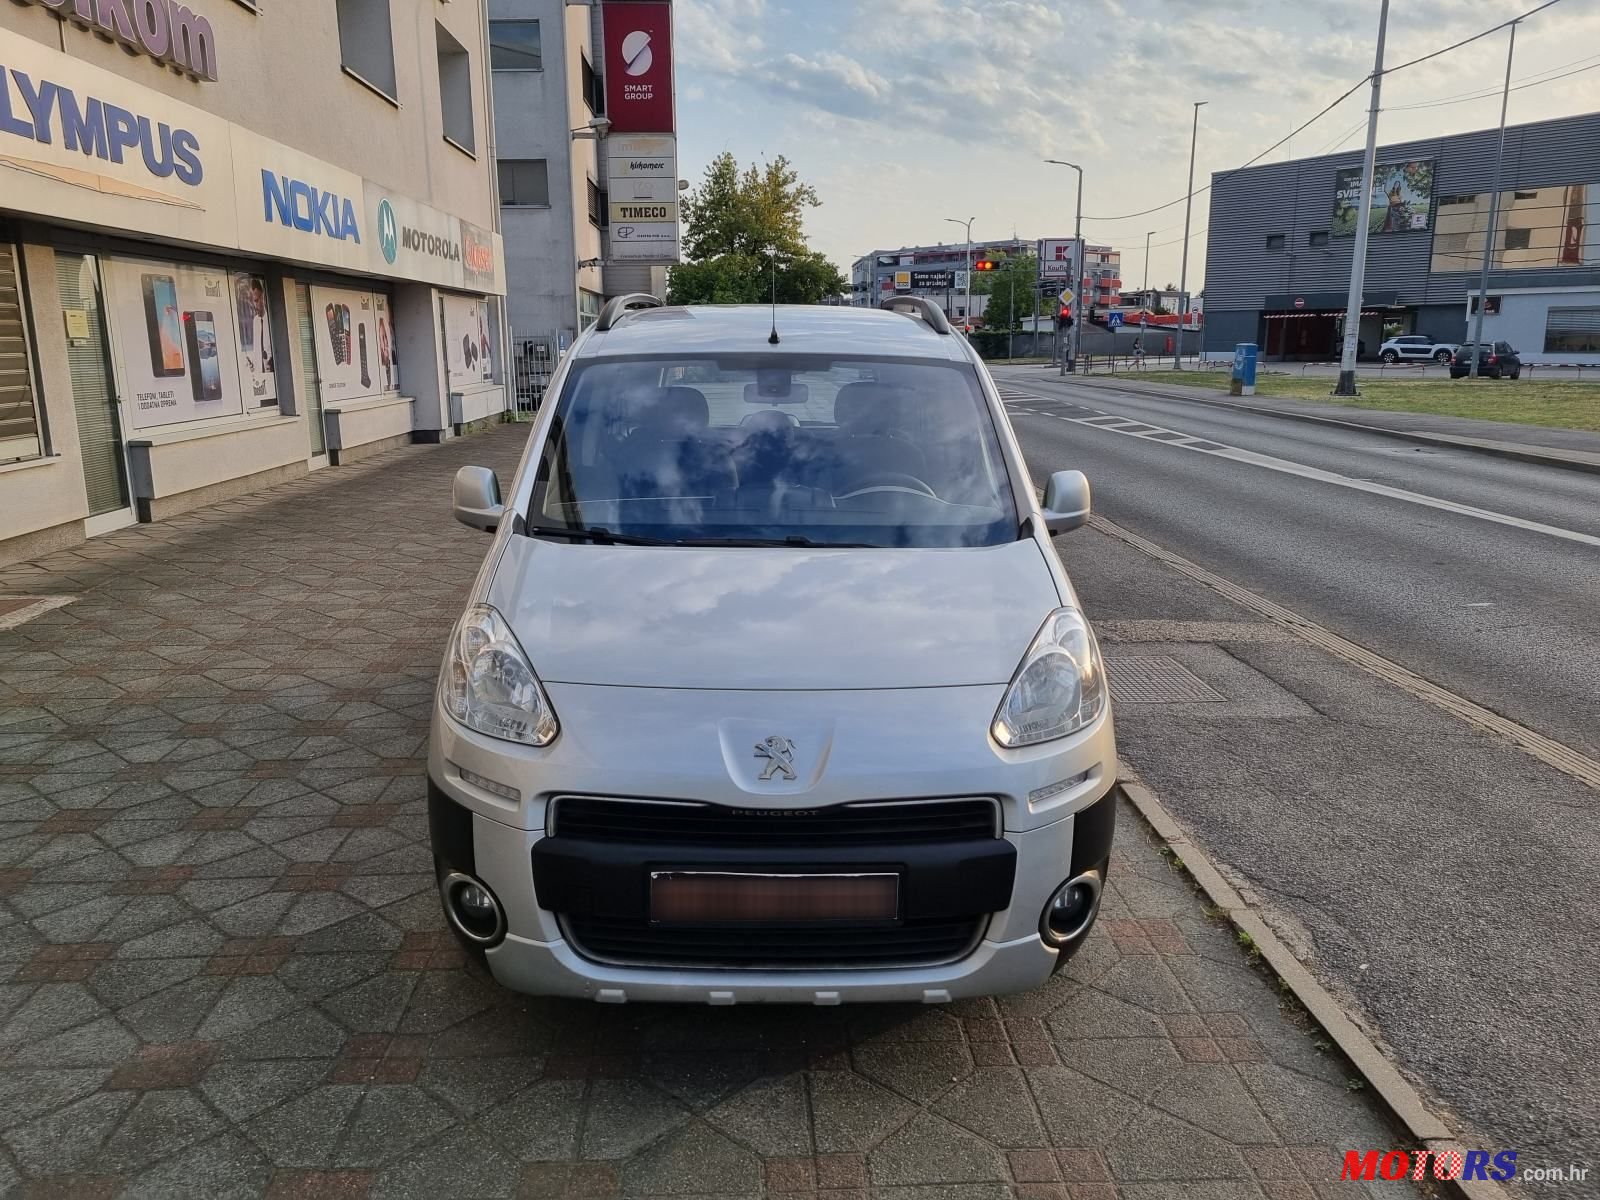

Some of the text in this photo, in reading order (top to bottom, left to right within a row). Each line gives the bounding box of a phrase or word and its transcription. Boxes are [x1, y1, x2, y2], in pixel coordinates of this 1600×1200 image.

[261, 168, 361, 245] NOKIA
[620, 206, 667, 218] TIMECO
[402, 226, 460, 262] MOTOROLA
